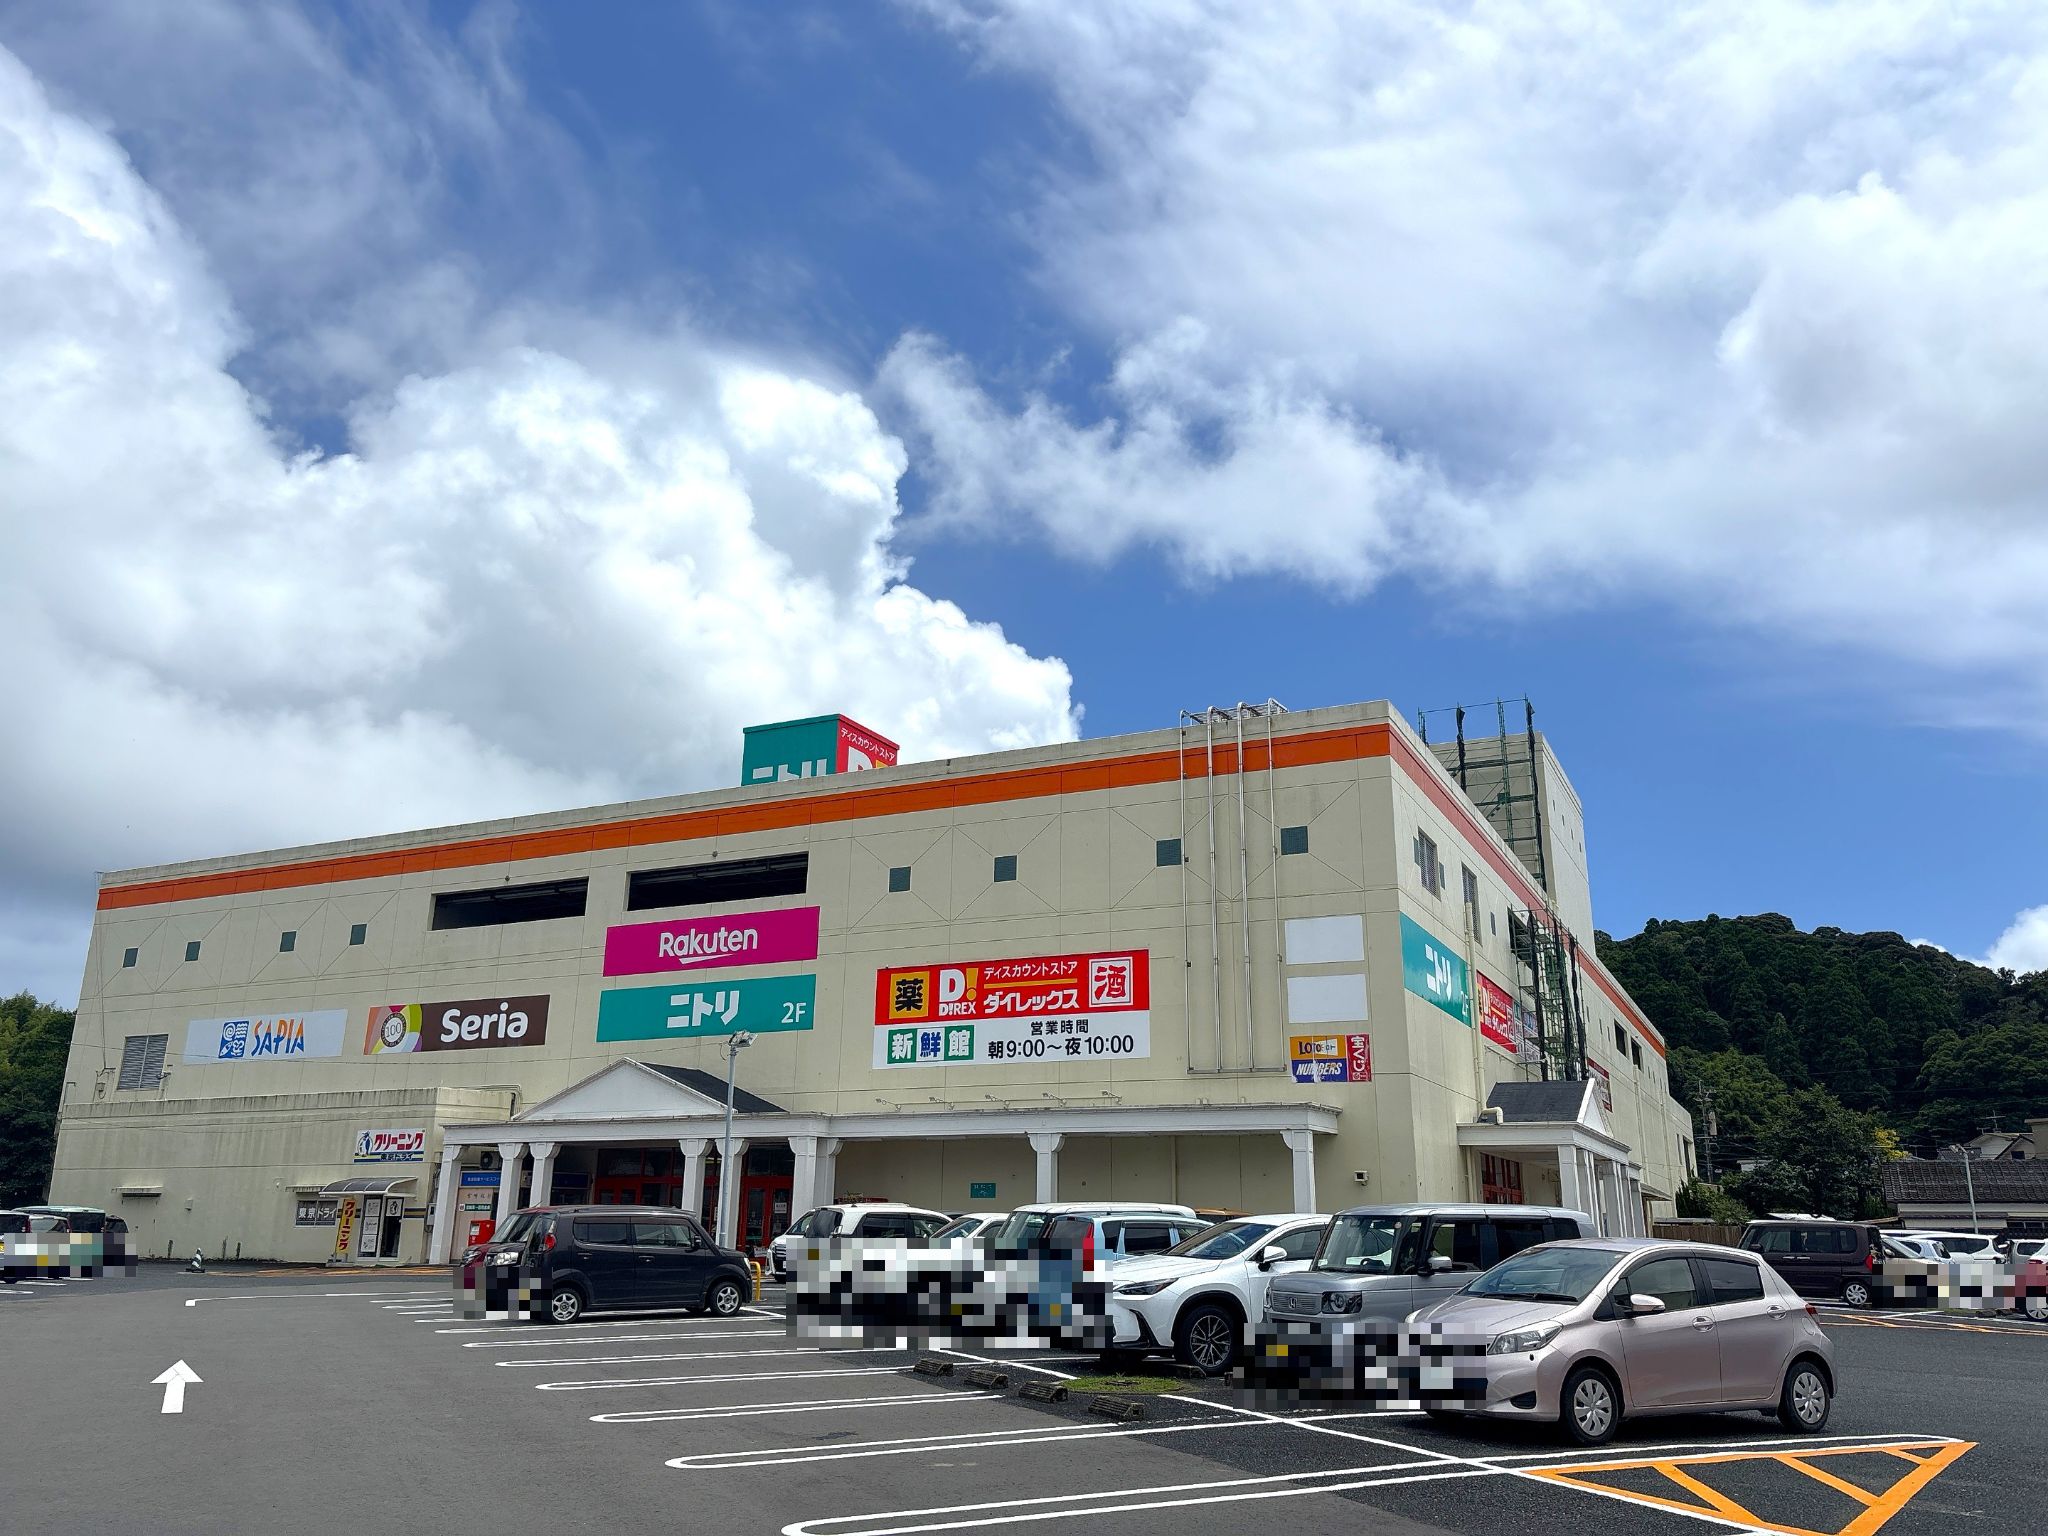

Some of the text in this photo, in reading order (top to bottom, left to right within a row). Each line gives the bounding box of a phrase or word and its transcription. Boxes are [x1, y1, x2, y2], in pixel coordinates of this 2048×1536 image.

[841, 727, 895, 762] ディスカウントストア
[658, 926, 758, 958] Rakuten
[984, 961, 1077, 980] ディスカウントストア
[1094, 965, 1127, 1001] 酒
[1425, 943, 1452, 1001] ニトリ
[666, 990, 806, 1028] ニトリ 2F
[895, 978, 924, 1012] 薬
[983, 989, 1080, 1014] ダイレックス
[251, 1017, 304, 1056] SAPIA
[386, 1022, 402, 1037] 100
[440, 1002, 528, 1043] Seria
[1030, 1019, 1089, 1036] 営業時間
[891, 1030, 970, 1060] 新鮮館
[1351, 1036, 1366, 1072] 宝くじ
[374, 1132, 424, 1151] クリーニング
[298, 1207, 337, 1219] 東京ドライ
[338, 1201, 356, 1250] クリーニング
